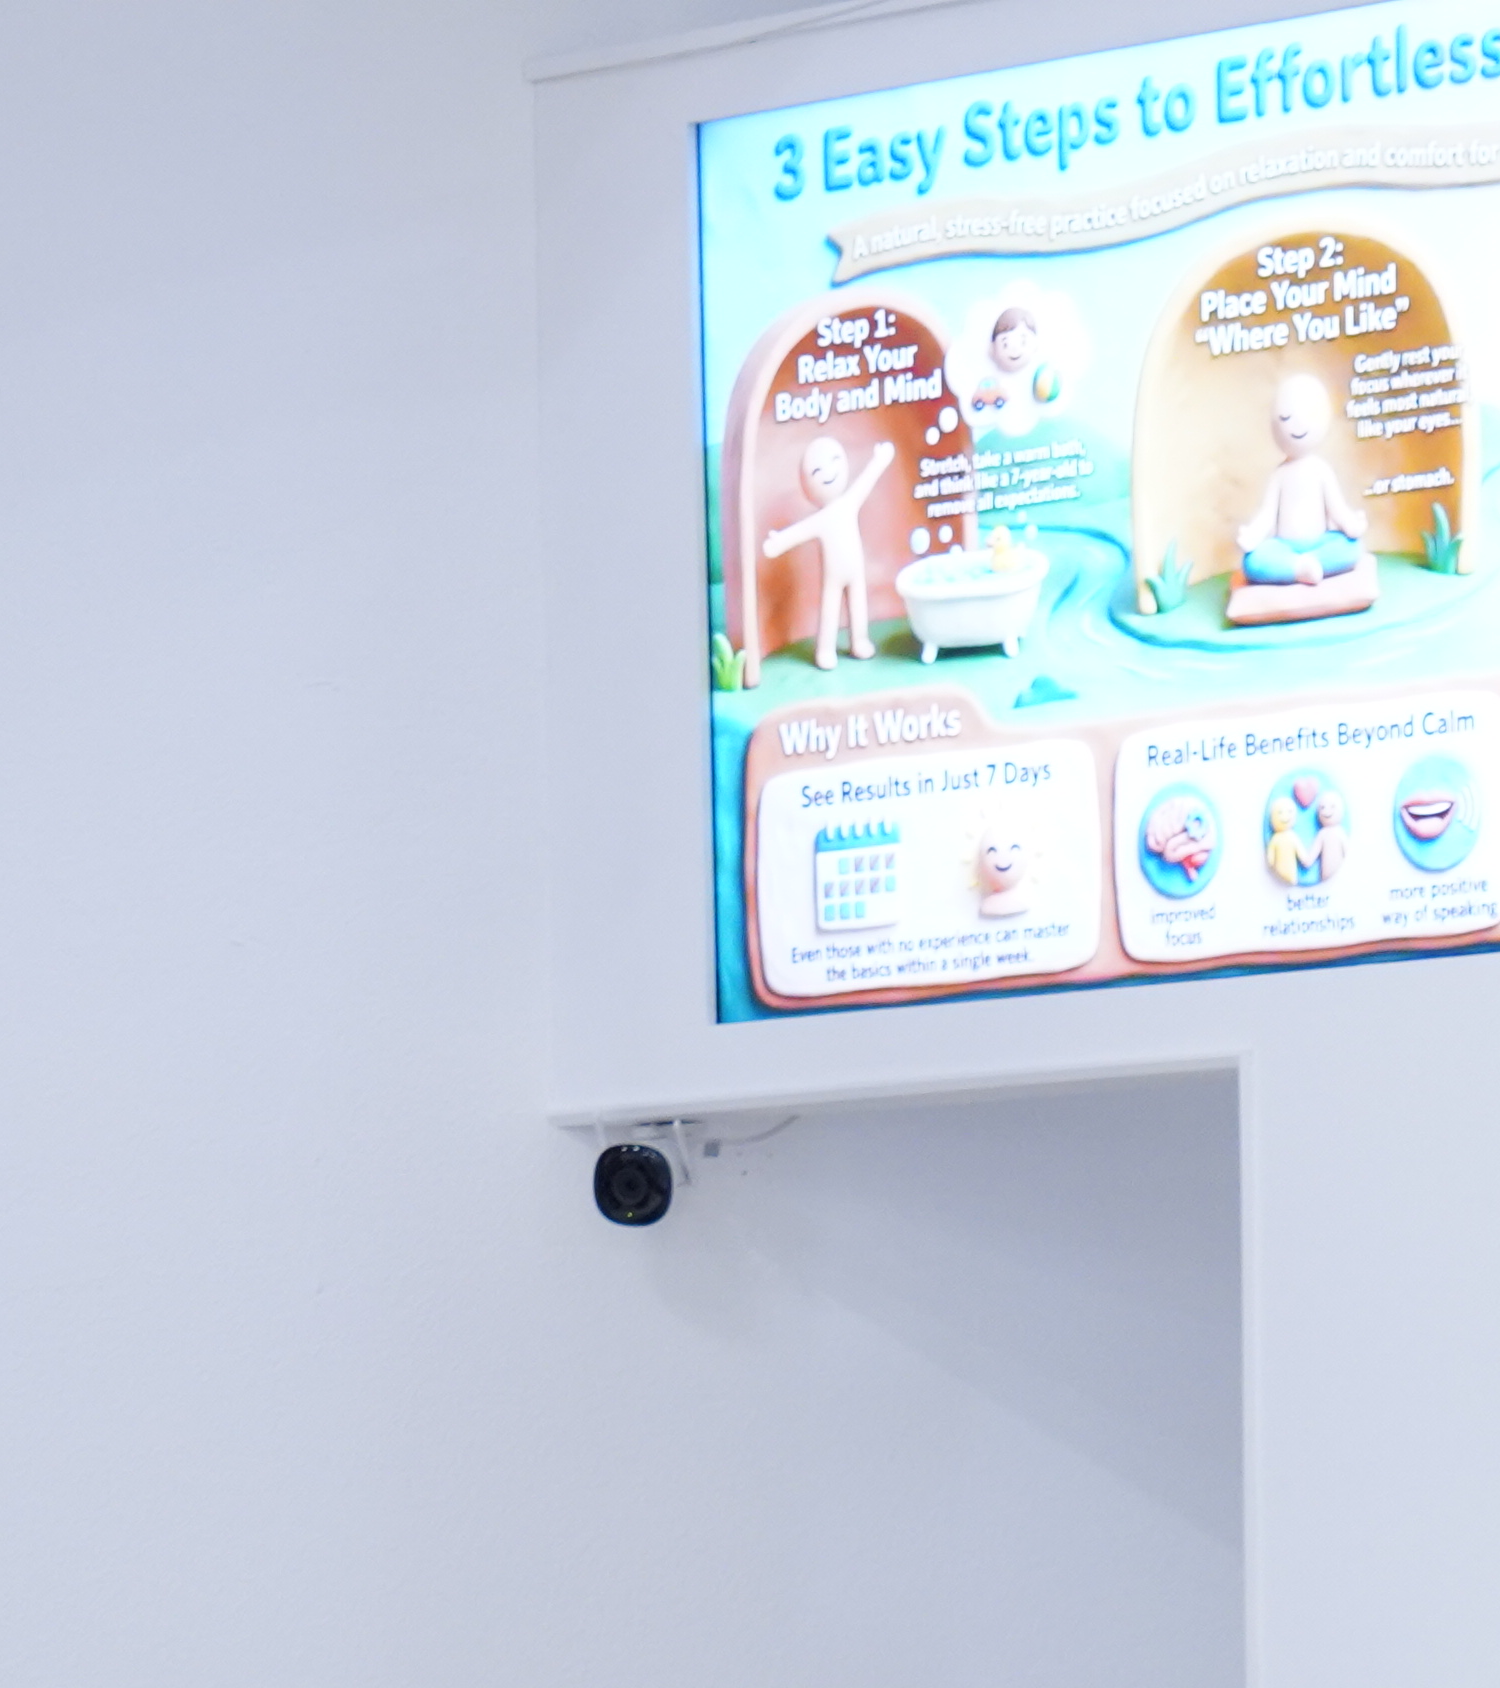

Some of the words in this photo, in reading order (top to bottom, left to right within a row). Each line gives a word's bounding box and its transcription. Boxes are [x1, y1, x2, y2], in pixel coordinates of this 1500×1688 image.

[774, 134, 805, 201] 3
[822, 124, 946, 196] Easy
[963, 97, 1120, 172] Steps
[1136, 76, 1195, 138] to
[852, 235, 868, 260] A
[869, 217, 941, 253] natural,
[945, 210, 1048, 239] stress-free
[1049, 204, 1128, 241] practice
[1129, 176, 1207, 220] focused
[1208, 171, 1235, 195] on
[1239, 145, 1339, 184] relaxation
[1340, 144, 1381, 170] and
[1384, 140, 1465, 169] comfort
[1468, 137, 1499, 167] for
[1257, 244, 1315, 278] Step
[1319, 236, 1344, 268] 2:
[1200, 289, 1268, 322] Place
[1270, 279, 1329, 311] Your
[1333, 262, 1397, 302] Mind
[816, 317, 870, 349] Step
[873, 308, 896, 339] 1:
[1195, 321, 1289, 355] “Where
[1292, 311, 1340, 343] You
[1345, 296, 1410, 336] Like”
[797, 351, 860, 384] Relax
[863, 343, 918, 373] Your
[774, 391, 832, 424] Body
[836, 379, 880, 412] and
[883, 368, 943, 405] Mind
[780, 718, 842, 759] Why
[847, 714, 869, 748] It
[872, 703, 963, 745] Works
[1147, 736, 1237, 768] Real-Life
[1245, 727, 1329, 758] Benefits
[1337, 715, 1414, 749] Beyond
[1422, 711, 1475, 736] Calm
[801, 785, 834, 808] See
[841, 776, 911, 803] Results
[918, 772, 934, 795] in
[941, 768, 979, 792] Just
[986, 764, 997, 785] 7
[1004, 762, 1051, 788] Days
[1286, 894, 1330, 911] better
[1390, 884, 1426, 899] more
[1431, 878, 1489, 902] positive
[1151, 905, 1216, 928] improved
[1263, 915, 1356, 938] relationships
[1382, 910, 1408, 927] way
[1415, 906, 1429, 923] of
[1433, 900, 1499, 924] speaking
[791, 947, 822, 964] Even
[825, 942, 861, 960] those
[867, 938, 895, 956] with
[898, 940, 914, 954] no
[918, 931, 991, 954] experience
[996, 928, 1019, 943] can
[1024, 922, 1071, 940] master
[1165, 930, 1203, 947] focus
[825, 965, 847, 982] the
[851, 961, 891, 980] basics
[897, 956, 937, 974] within
[941, 959, 948, 971] a
[952, 953, 992, 975] single
